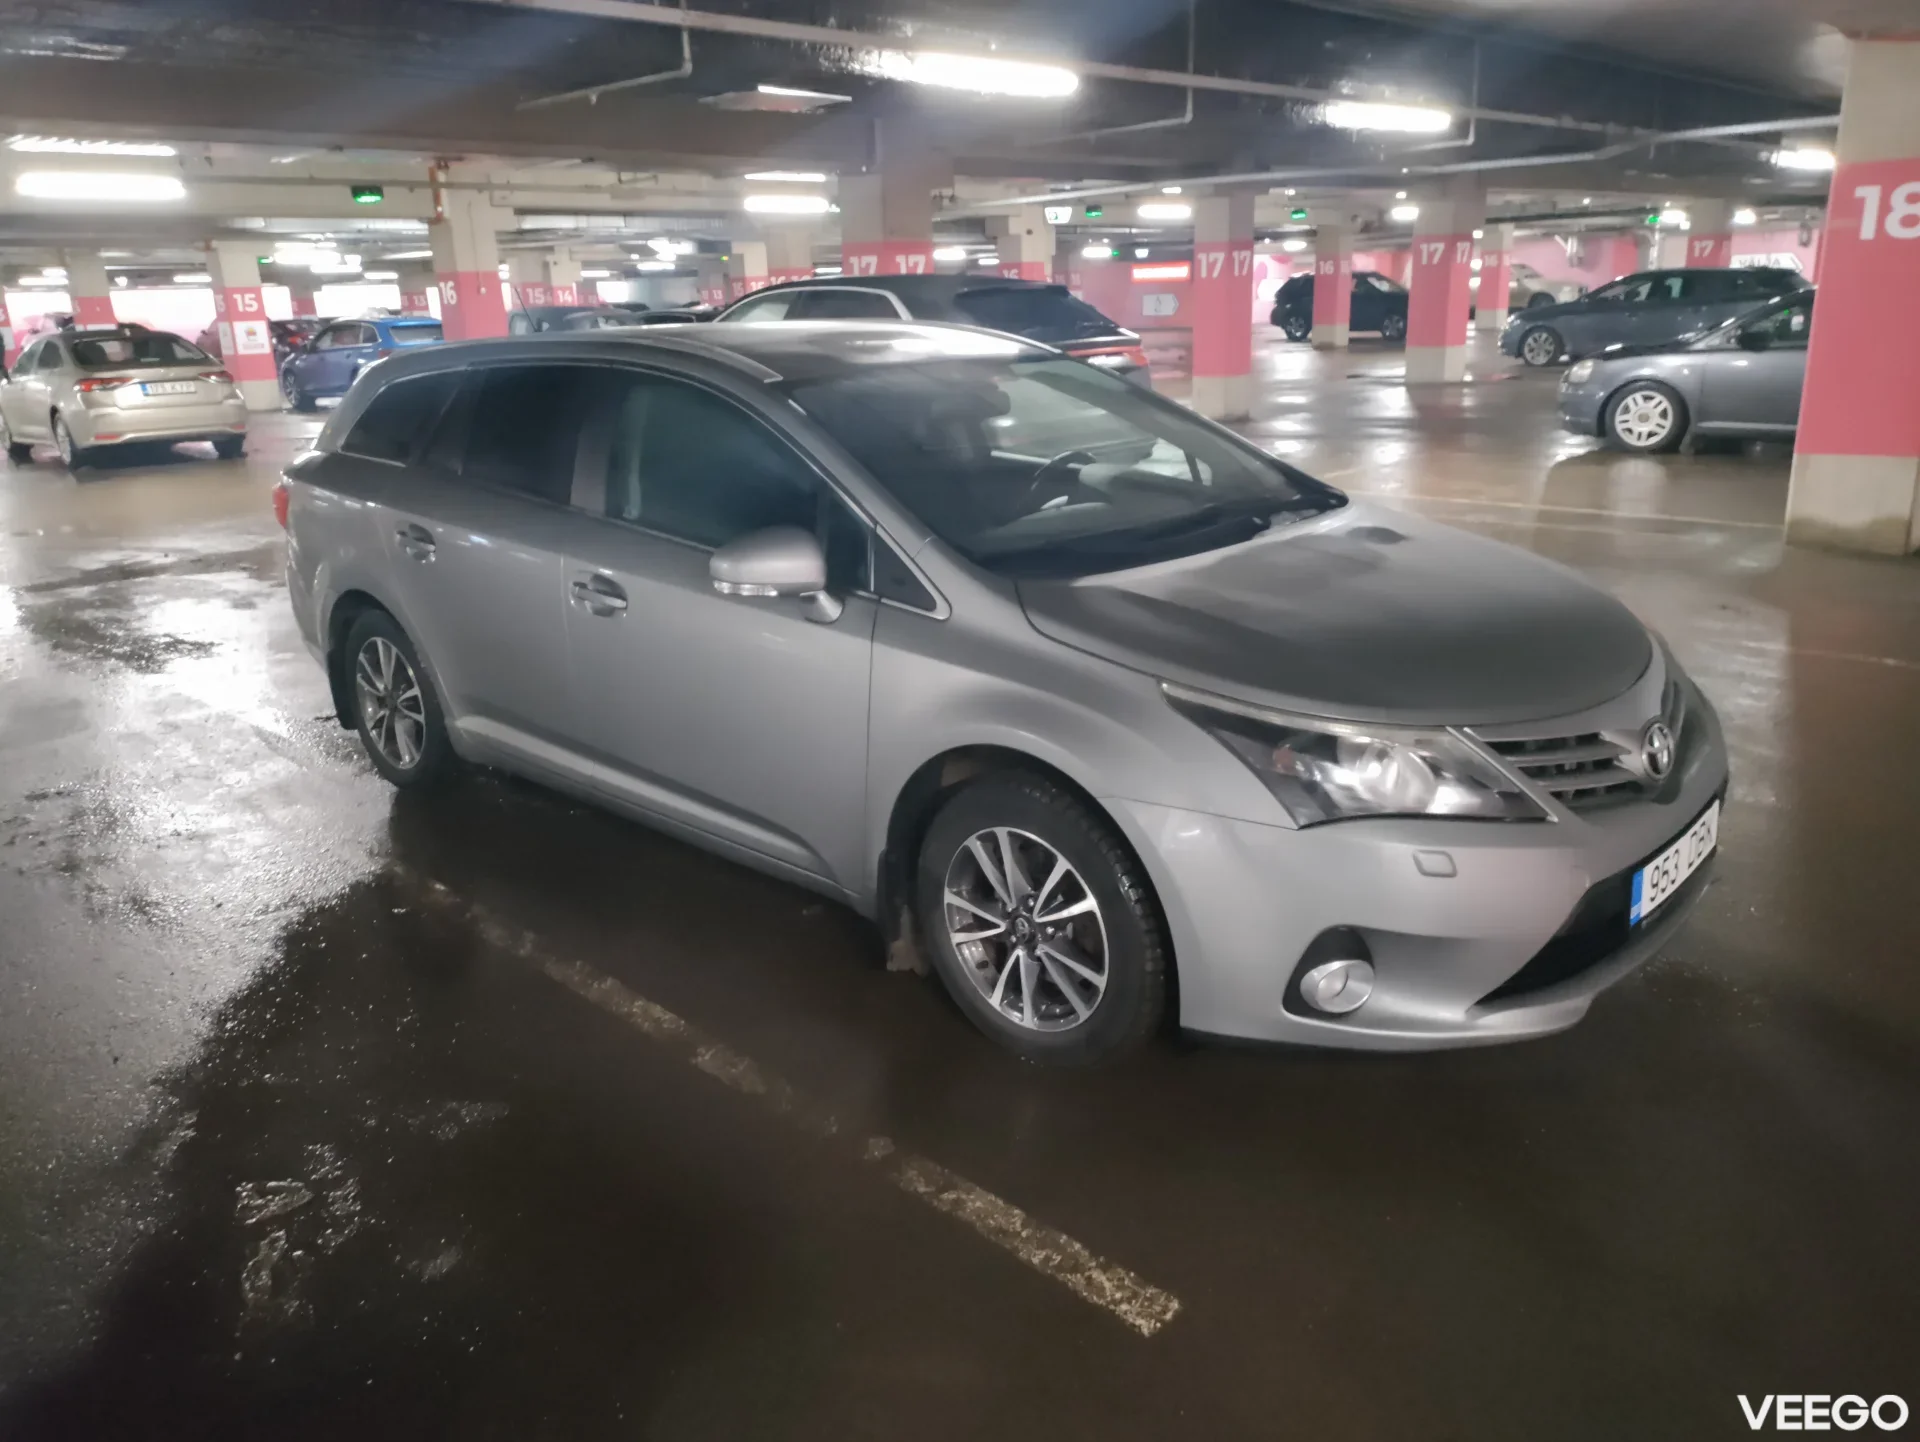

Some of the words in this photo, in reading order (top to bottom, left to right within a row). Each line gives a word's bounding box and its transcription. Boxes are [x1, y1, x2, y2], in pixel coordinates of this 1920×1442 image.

[1854, 181, 1920, 240] 18
[1420, 243, 1445, 266] 17
[1456, 241, 1471, 264] 17
[1693, 240, 1715, 258] 17
[848, 255, 878, 275] 17
[896, 254, 926, 275] 17
[1197, 253, 1225, 278] 17
[1232, 250, 1251, 277] 17
[1319, 260, 1334, 275] 16
[232, 293, 259, 313] 15
[438, 281, 458, 305] 16
[526, 288, 545, 305] 15
[1649, 848, 1680, 903] 953
